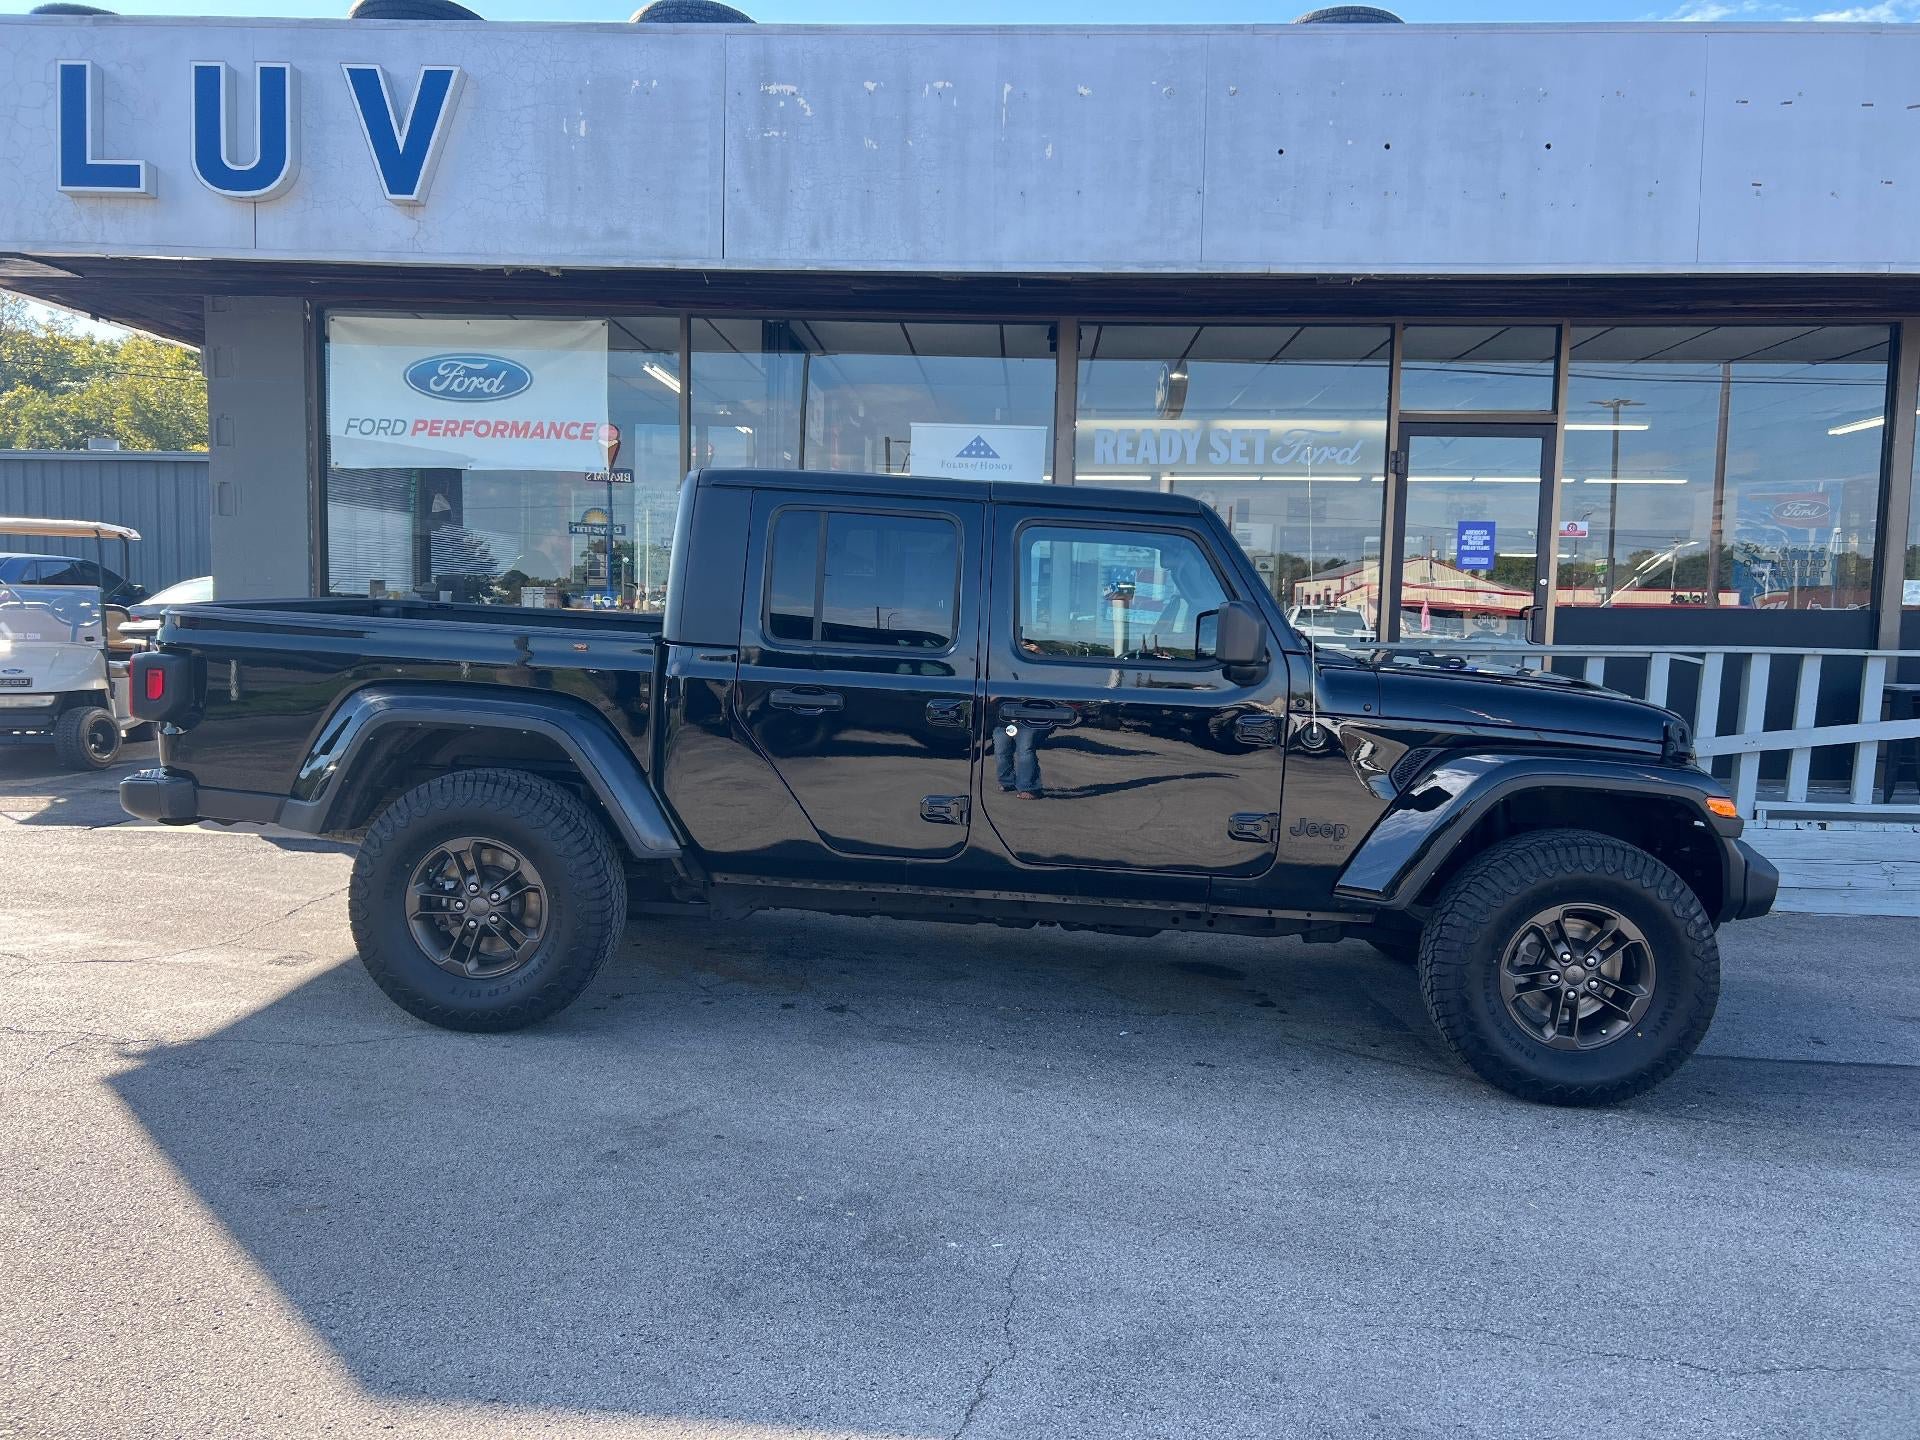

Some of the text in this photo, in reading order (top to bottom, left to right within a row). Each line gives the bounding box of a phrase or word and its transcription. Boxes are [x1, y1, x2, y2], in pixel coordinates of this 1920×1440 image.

[56, 58, 465, 206] LUV
[429, 360, 508, 394] Ford
[344, 417, 597, 441] FORD PERFORMANCE
[1094, 428, 1361, 466] READY SET Ford
[1782, 503, 1820, 517] Ford
[1290, 818, 1350, 842] Jeep
